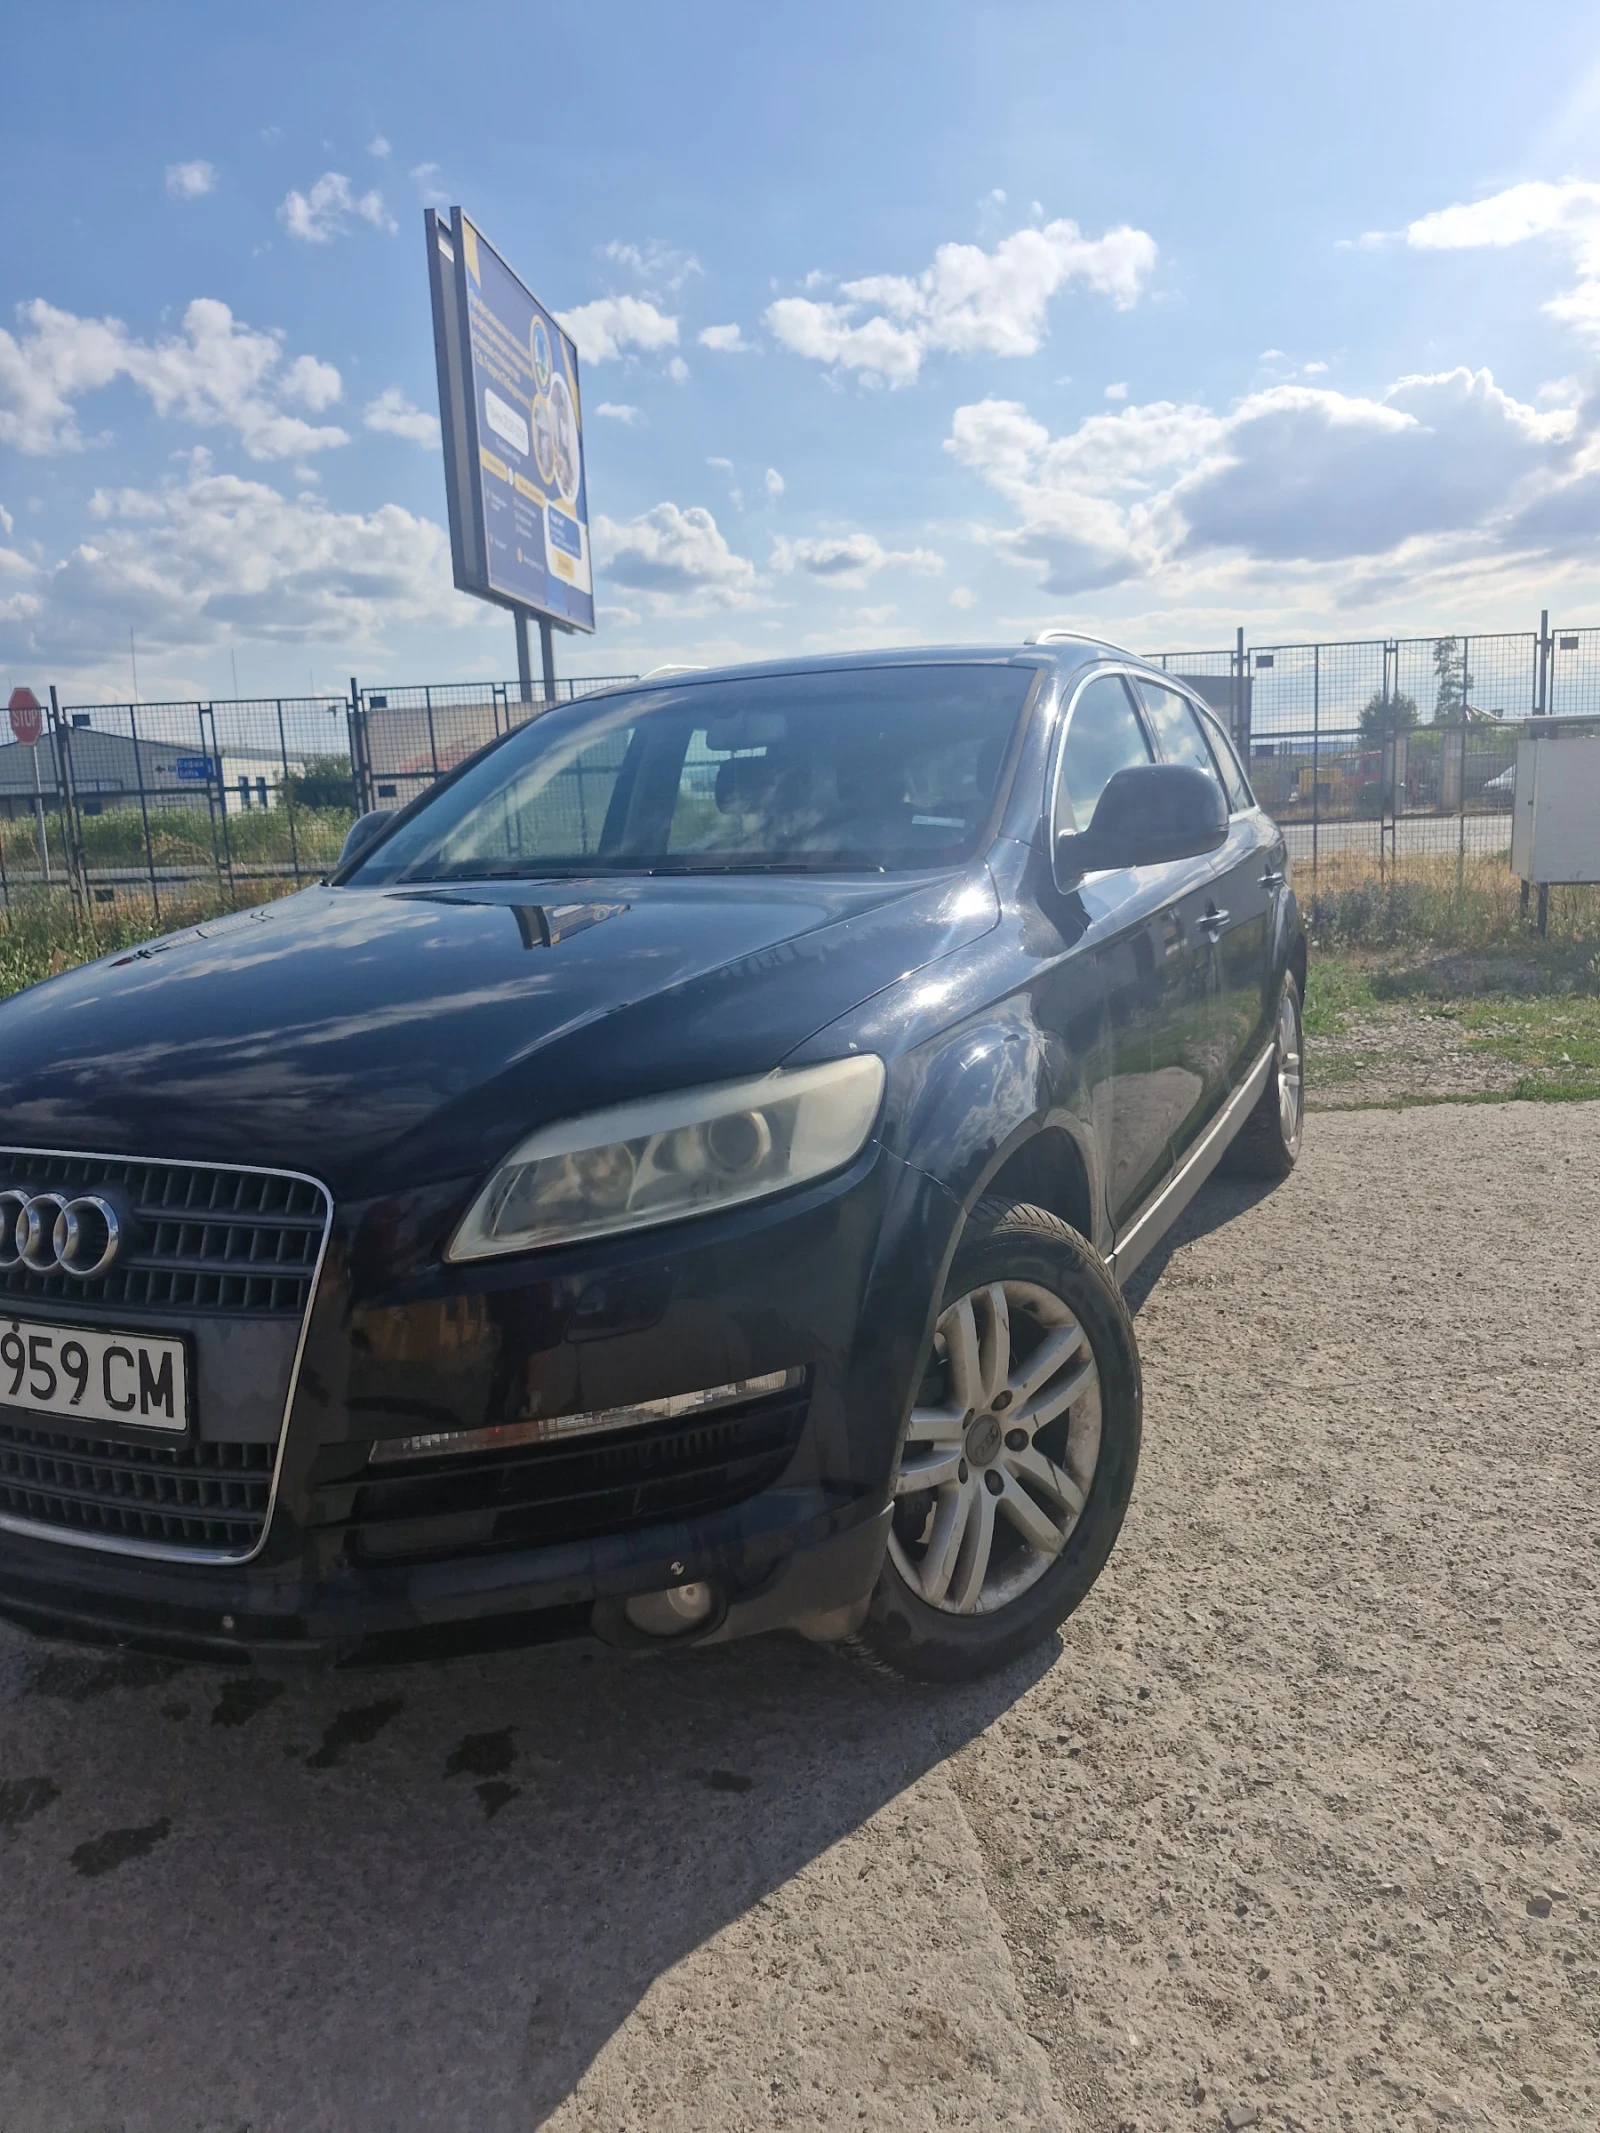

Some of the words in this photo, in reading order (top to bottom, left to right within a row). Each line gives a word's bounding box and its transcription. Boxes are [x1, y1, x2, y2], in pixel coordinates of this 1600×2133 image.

[12, 708, 37, 727] STOP
[1, 1332, 89, 1405] 959
[102, 1346, 174, 1418] CM
